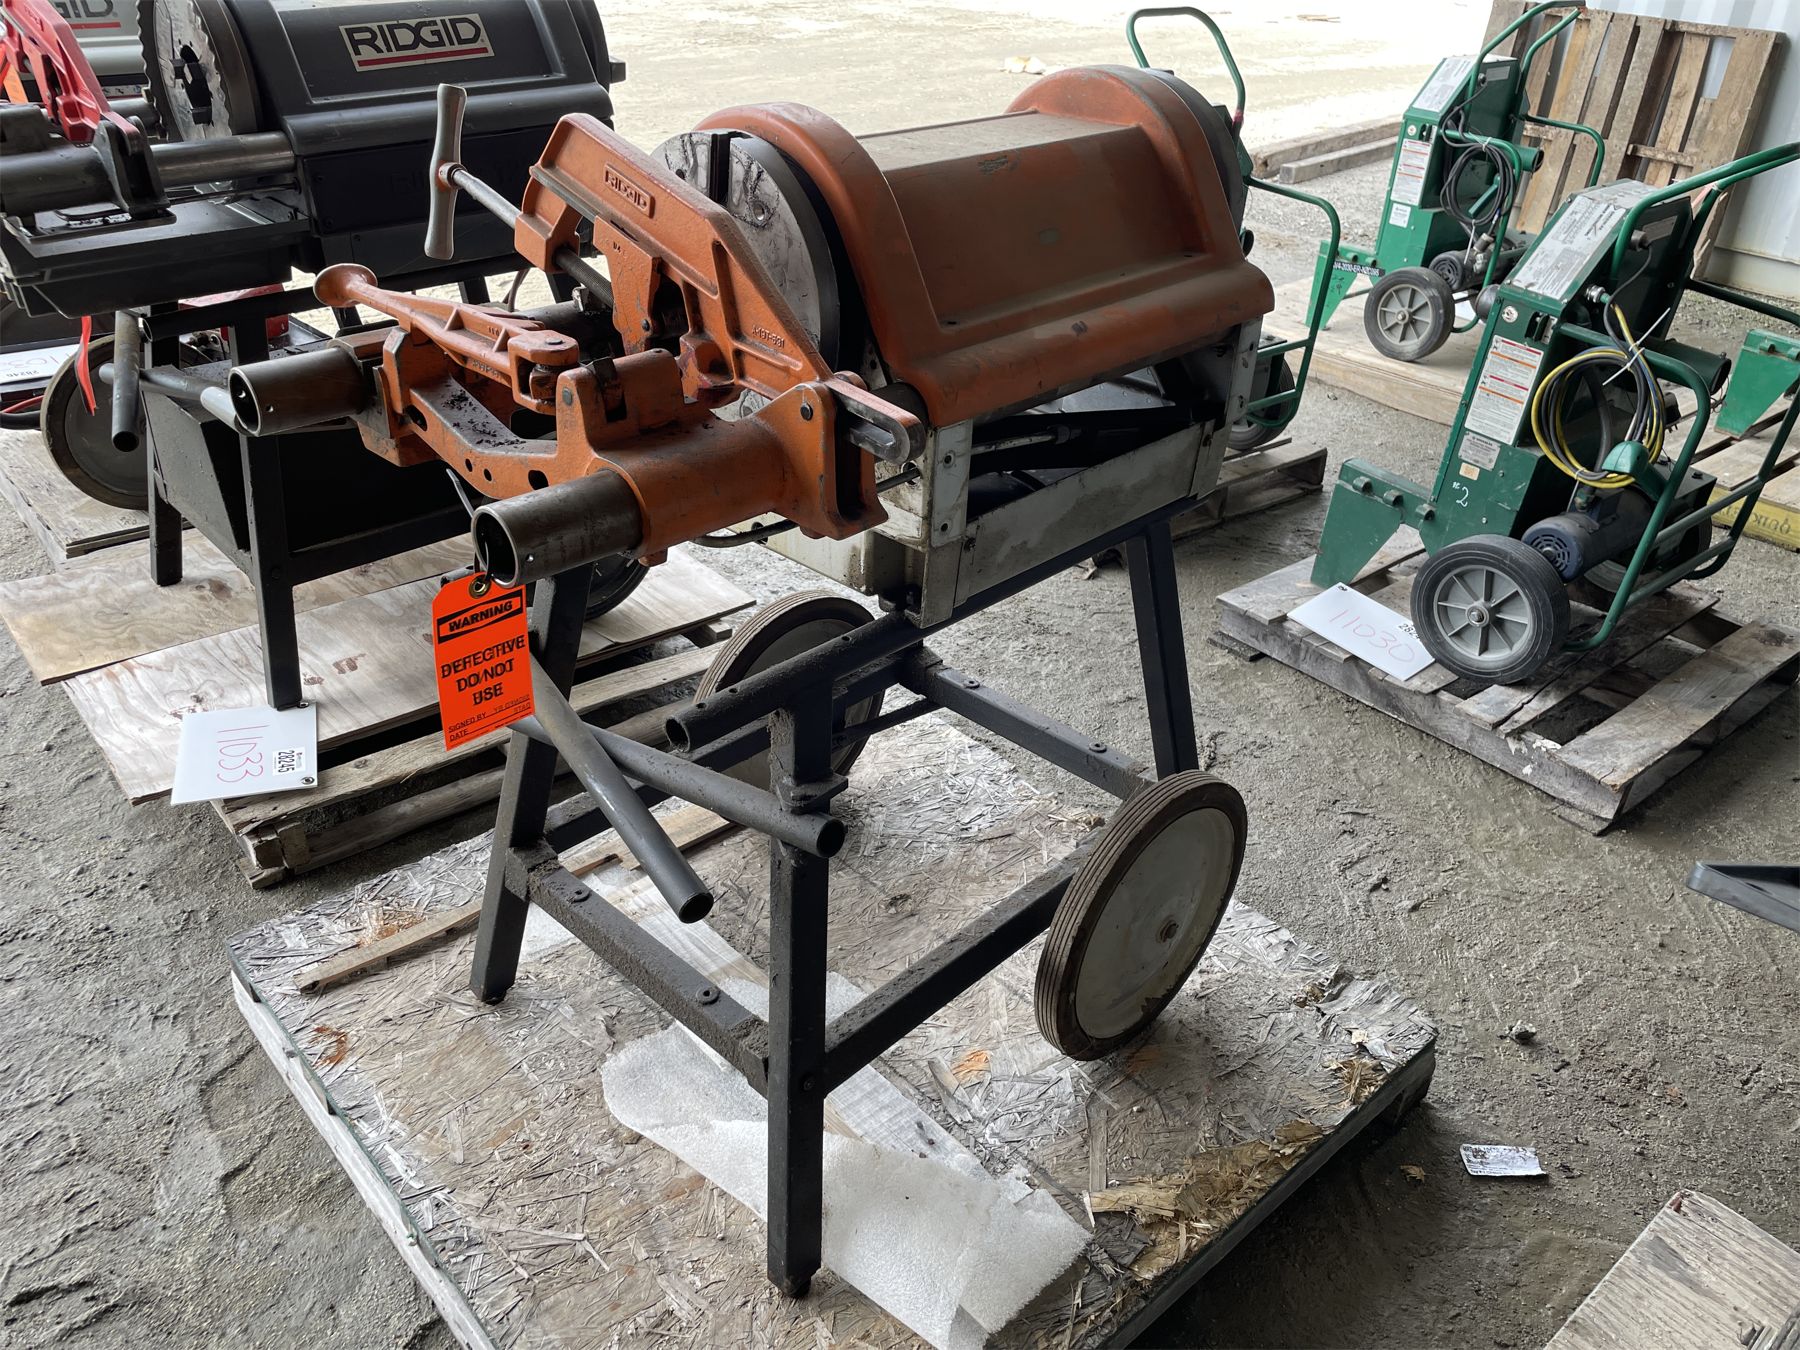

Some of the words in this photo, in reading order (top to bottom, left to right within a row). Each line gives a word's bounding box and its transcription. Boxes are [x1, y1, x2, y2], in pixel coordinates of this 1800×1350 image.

[345, 17, 482, 56] RIDGID
[604, 169, 648, 210] RIDGID
[448, 600, 513, 633] WARNING
[1329, 609, 1415, 663] 11030
[441, 634, 526, 679] DEFECTIVE
[456, 672, 480, 692] DO
[482, 658, 515, 682] NOT
[472, 682, 504, 706] USE
[448, 717, 476, 734] SIGNED
[475, 712, 486, 722] BY
[449, 728, 469, 742] DATE
[278, 749, 295, 773] 28245
